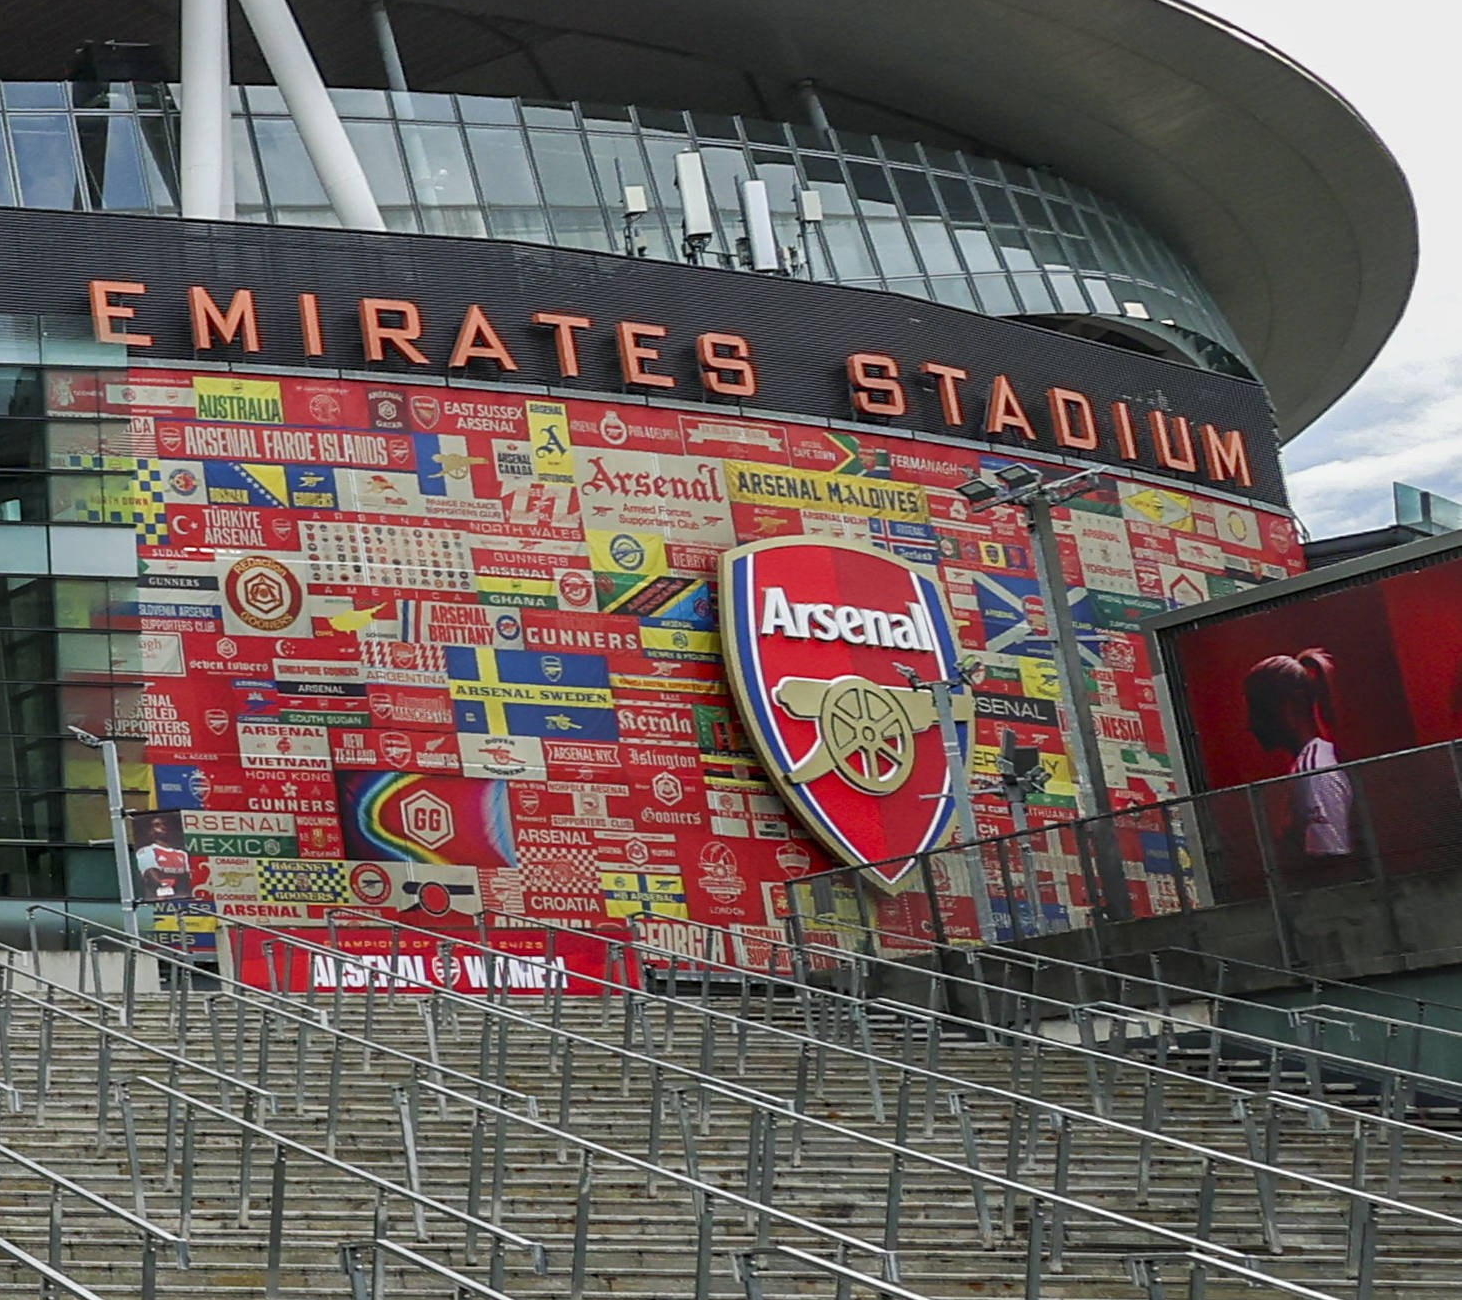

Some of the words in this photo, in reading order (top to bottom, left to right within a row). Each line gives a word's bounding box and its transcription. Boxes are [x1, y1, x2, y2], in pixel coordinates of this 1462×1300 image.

[89, 279, 757, 397] EMIRATES
[846, 352, 1255, 487] STADIUM
[198, 394, 283, 423] AUSTRALIA
[444, 401, 475, 417] EAST
[478, 403, 524, 419] SUSSEX
[455, 417, 517, 433] ARSENAL
[185, 426, 262, 458] ARSENAL
[265, 430, 316, 462] FAROE
[318, 432, 389, 465] ISLANDS
[497, 452, 532, 465] ARSENAL
[890, 454, 958, 476] FERMANAGH
[498, 463, 533, 476] CANADA
[581, 456, 725, 503] Arsenal
[737, 471, 822, 502] ARSENAL
[826, 481, 920, 513] MALDIVES
[202, 506, 261, 529] TÜRKİYE
[478, 510, 501, 519] CLUB
[623, 504, 655, 514] Armed
[658, 506, 692, 517] Forces
[313, 512, 452, 528] ARSENAL
[619, 514, 675, 528] Supporters
[678, 519, 700, 530] Club
[204, 526, 267, 547] ARSENAL
[469, 522, 523, 535] NORTH
[529, 526, 582, 540] WALES
[493, 552, 569, 567] GUNNERS
[479, 565, 551, 579] ARSENAL
[148, 577, 200, 587] GUNNERS
[489, 595, 547, 607] GHANA
[138, 603, 176, 616] SLOVENIA
[179, 605, 215, 618] ARSENAL
[430, 604, 491, 626] ARSENAL
[141, 618, 193, 632] SUPPORTERS
[195, 620, 216, 633] CLUB
[761, 586, 934, 652] Arsenal
[428, 624, 494, 645] BRITTANY
[526, 627, 638, 650] GUNNERS
[367, 670, 447, 685] ARGENTINA
[298, 684, 345, 694] ARSENAL
[456, 684, 534, 699] ARSENAL
[540, 691, 608, 703] SWEDEN
[115, 706, 178, 720] DISABLED
[977, 697, 1048, 721] SENAL
[104, 719, 191, 735] SUPPORTERS
[288, 714, 324, 723] SOUTH
[327, 715, 362, 725] SUDAN
[618, 709, 693, 734] Kerala
[241, 725, 324, 737] ARSENAL
[247, 756, 327, 768] VIETNAM
[628, 748, 697, 770] Islington
[245, 771, 286, 781] HONG
[290, 772, 332, 782] KONG
[548, 783, 588, 794] NORFOLK
[590, 786, 629, 796] ARSENAL
[248, 797, 336, 813] GUNNERS
[184, 814, 289, 833] RSENAL
[415, 807, 442, 832] GG
[551, 816, 607, 827] SUPPORTERS
[611, 818, 634, 829] CLUB
[641, 807, 702, 825] Gooners
[517, 829, 592, 845] ARSENAL
[275, 892, 335, 902] GOONERS
[530, 896, 601, 912] CROATIA
[222, 904, 302, 919] ARSENAL
[324, 941, 407, 949] CAMPIOS
[633, 920, 726, 963] GEORGIA
